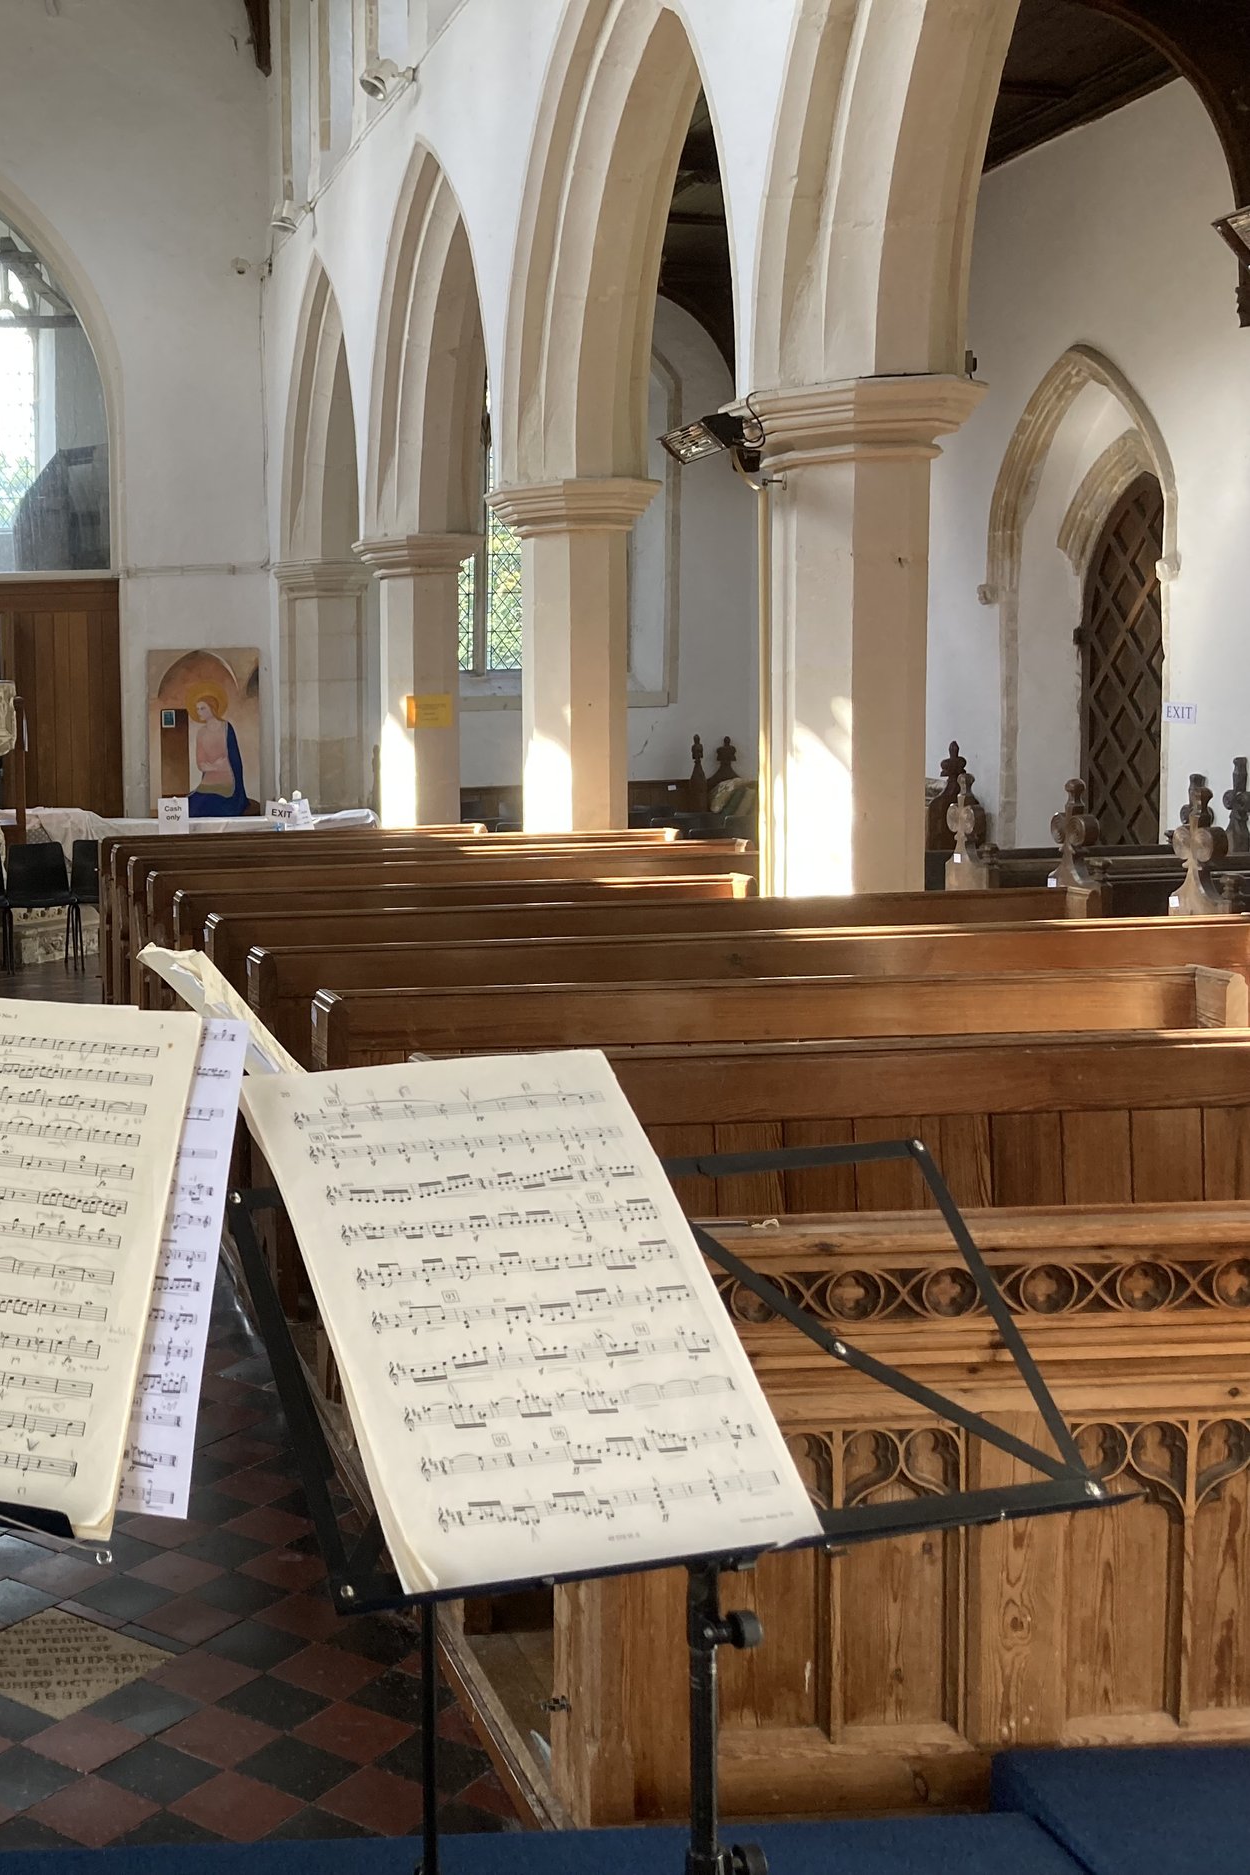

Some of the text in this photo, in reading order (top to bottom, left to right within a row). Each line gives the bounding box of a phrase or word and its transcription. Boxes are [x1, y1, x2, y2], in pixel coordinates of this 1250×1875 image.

[1166, 705, 1193, 719] EXIT
[166, 813, 181, 821] only
[271, 808, 293, 818] EXIT
[46, 1626, 98, 1634] STONE
